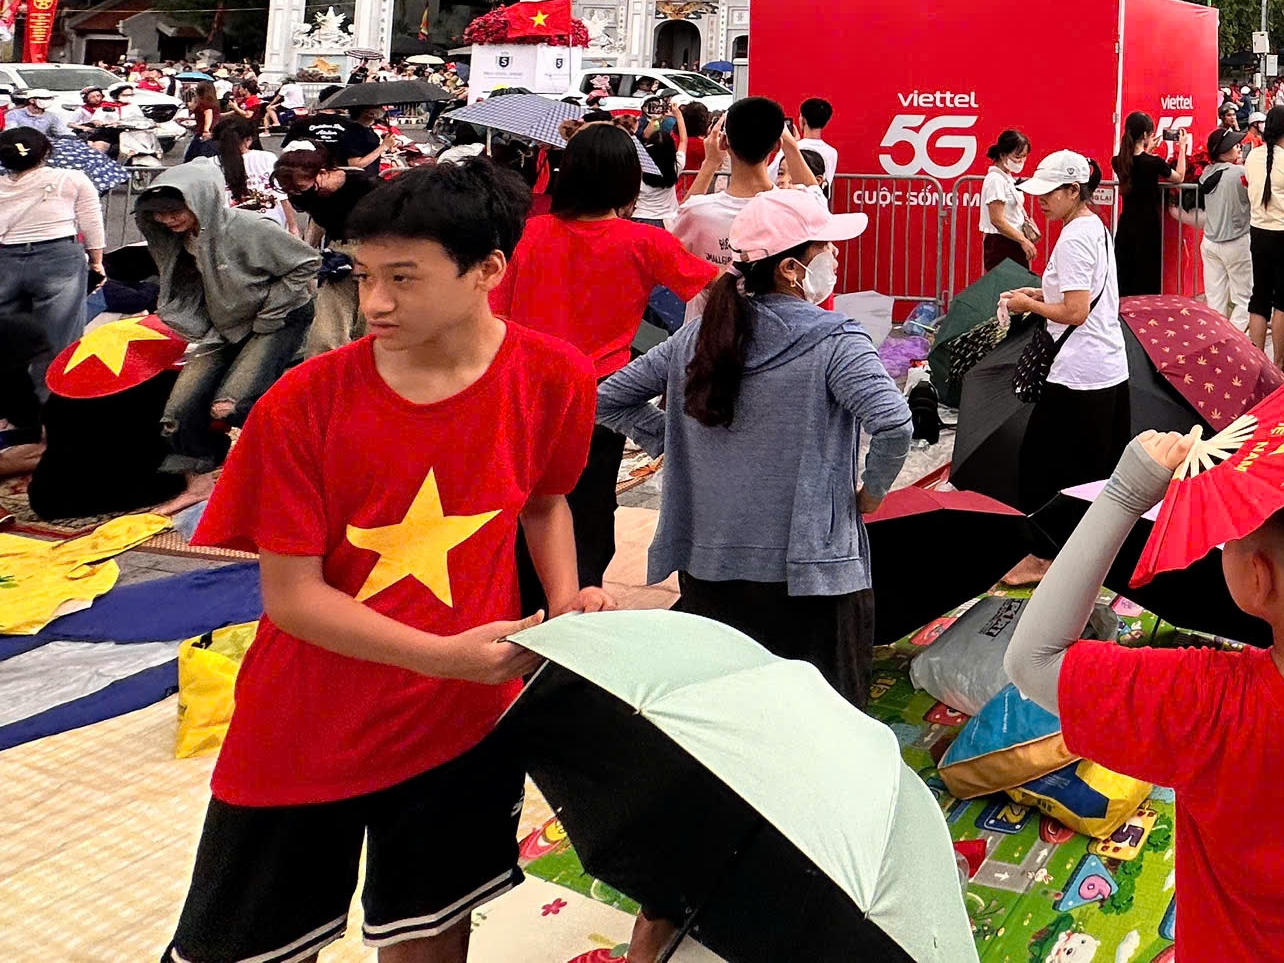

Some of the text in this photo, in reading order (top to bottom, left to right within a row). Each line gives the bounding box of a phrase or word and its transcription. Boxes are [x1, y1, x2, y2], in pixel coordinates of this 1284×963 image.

[898, 90, 979, 108] viettel
[1161, 94, 1194, 110] viettel
[879, 114, 978, 179] 5G
[853, 186, 903, 207] CUỘC
[906, 184, 959, 209] SỐNG
